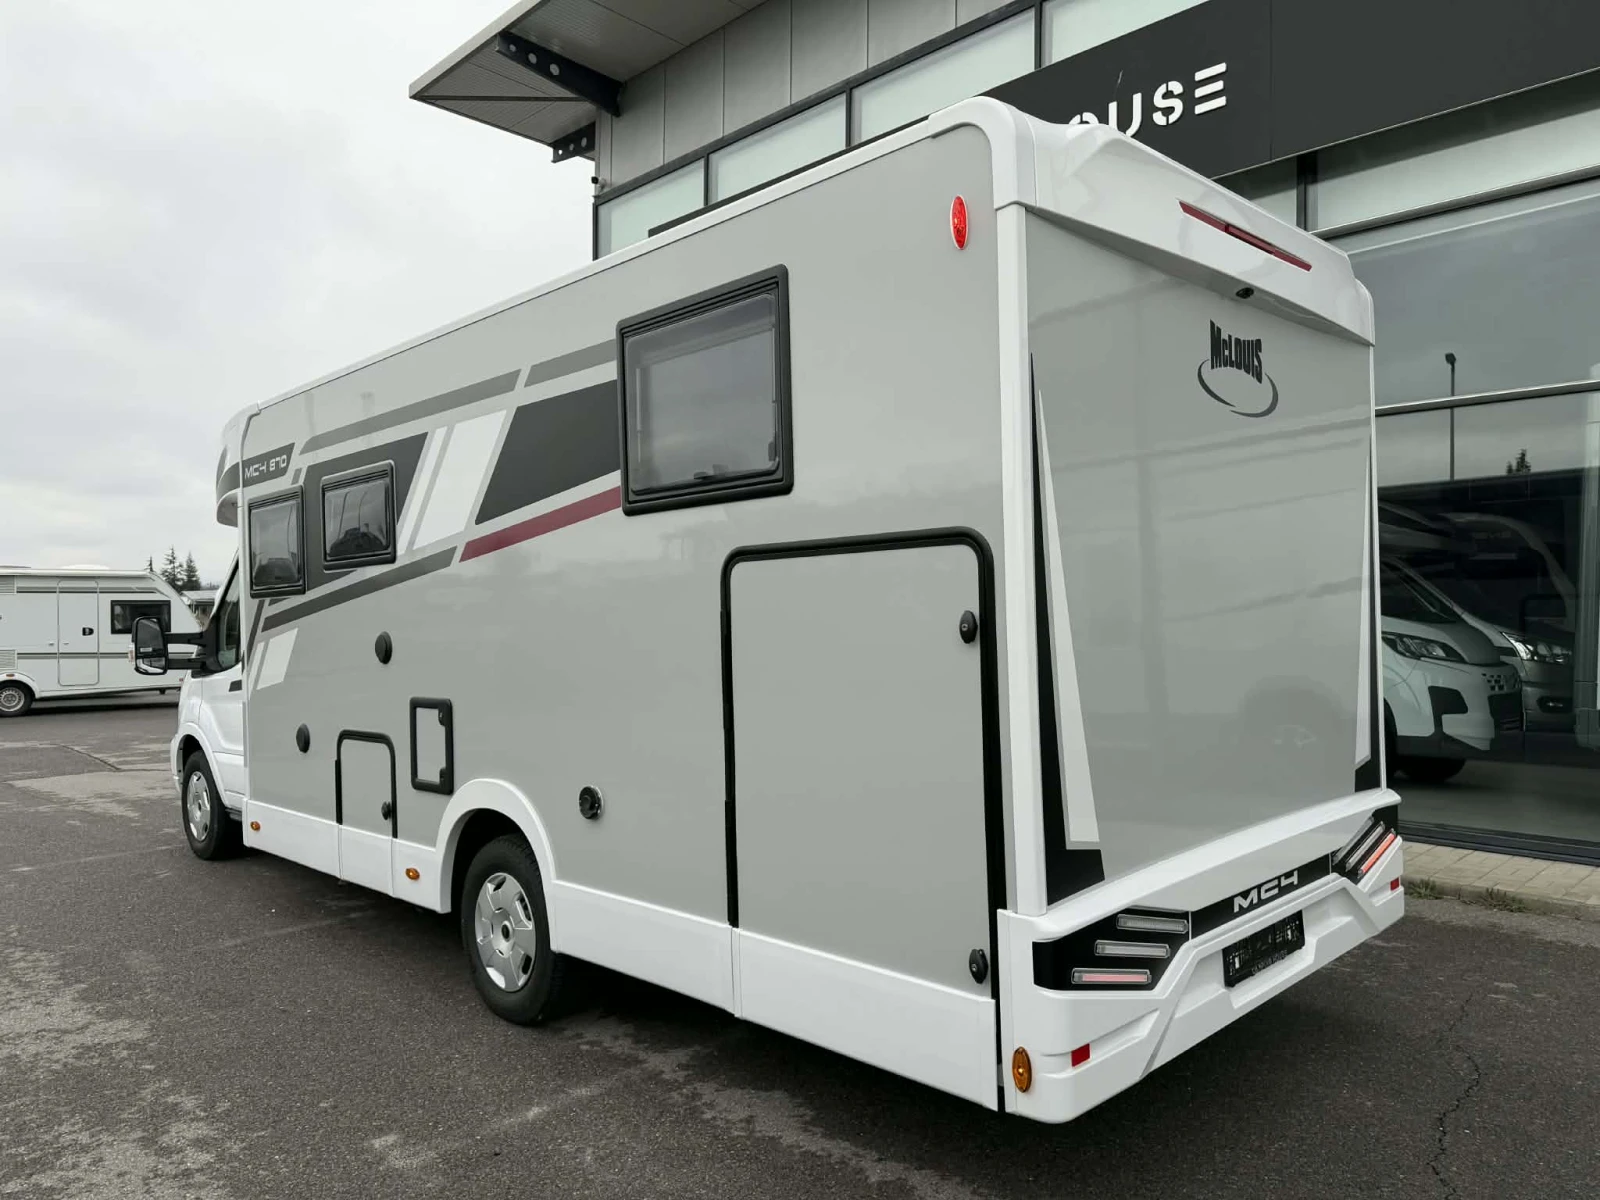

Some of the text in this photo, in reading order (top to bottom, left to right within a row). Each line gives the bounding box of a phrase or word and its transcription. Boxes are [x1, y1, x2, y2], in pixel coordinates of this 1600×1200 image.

[1068, 62, 1227, 137] USE
[1209, 318, 1263, 384] McLOUIS
[244, 454, 288, 480] MC4 870
[1233, 870, 1299, 913] MC4
